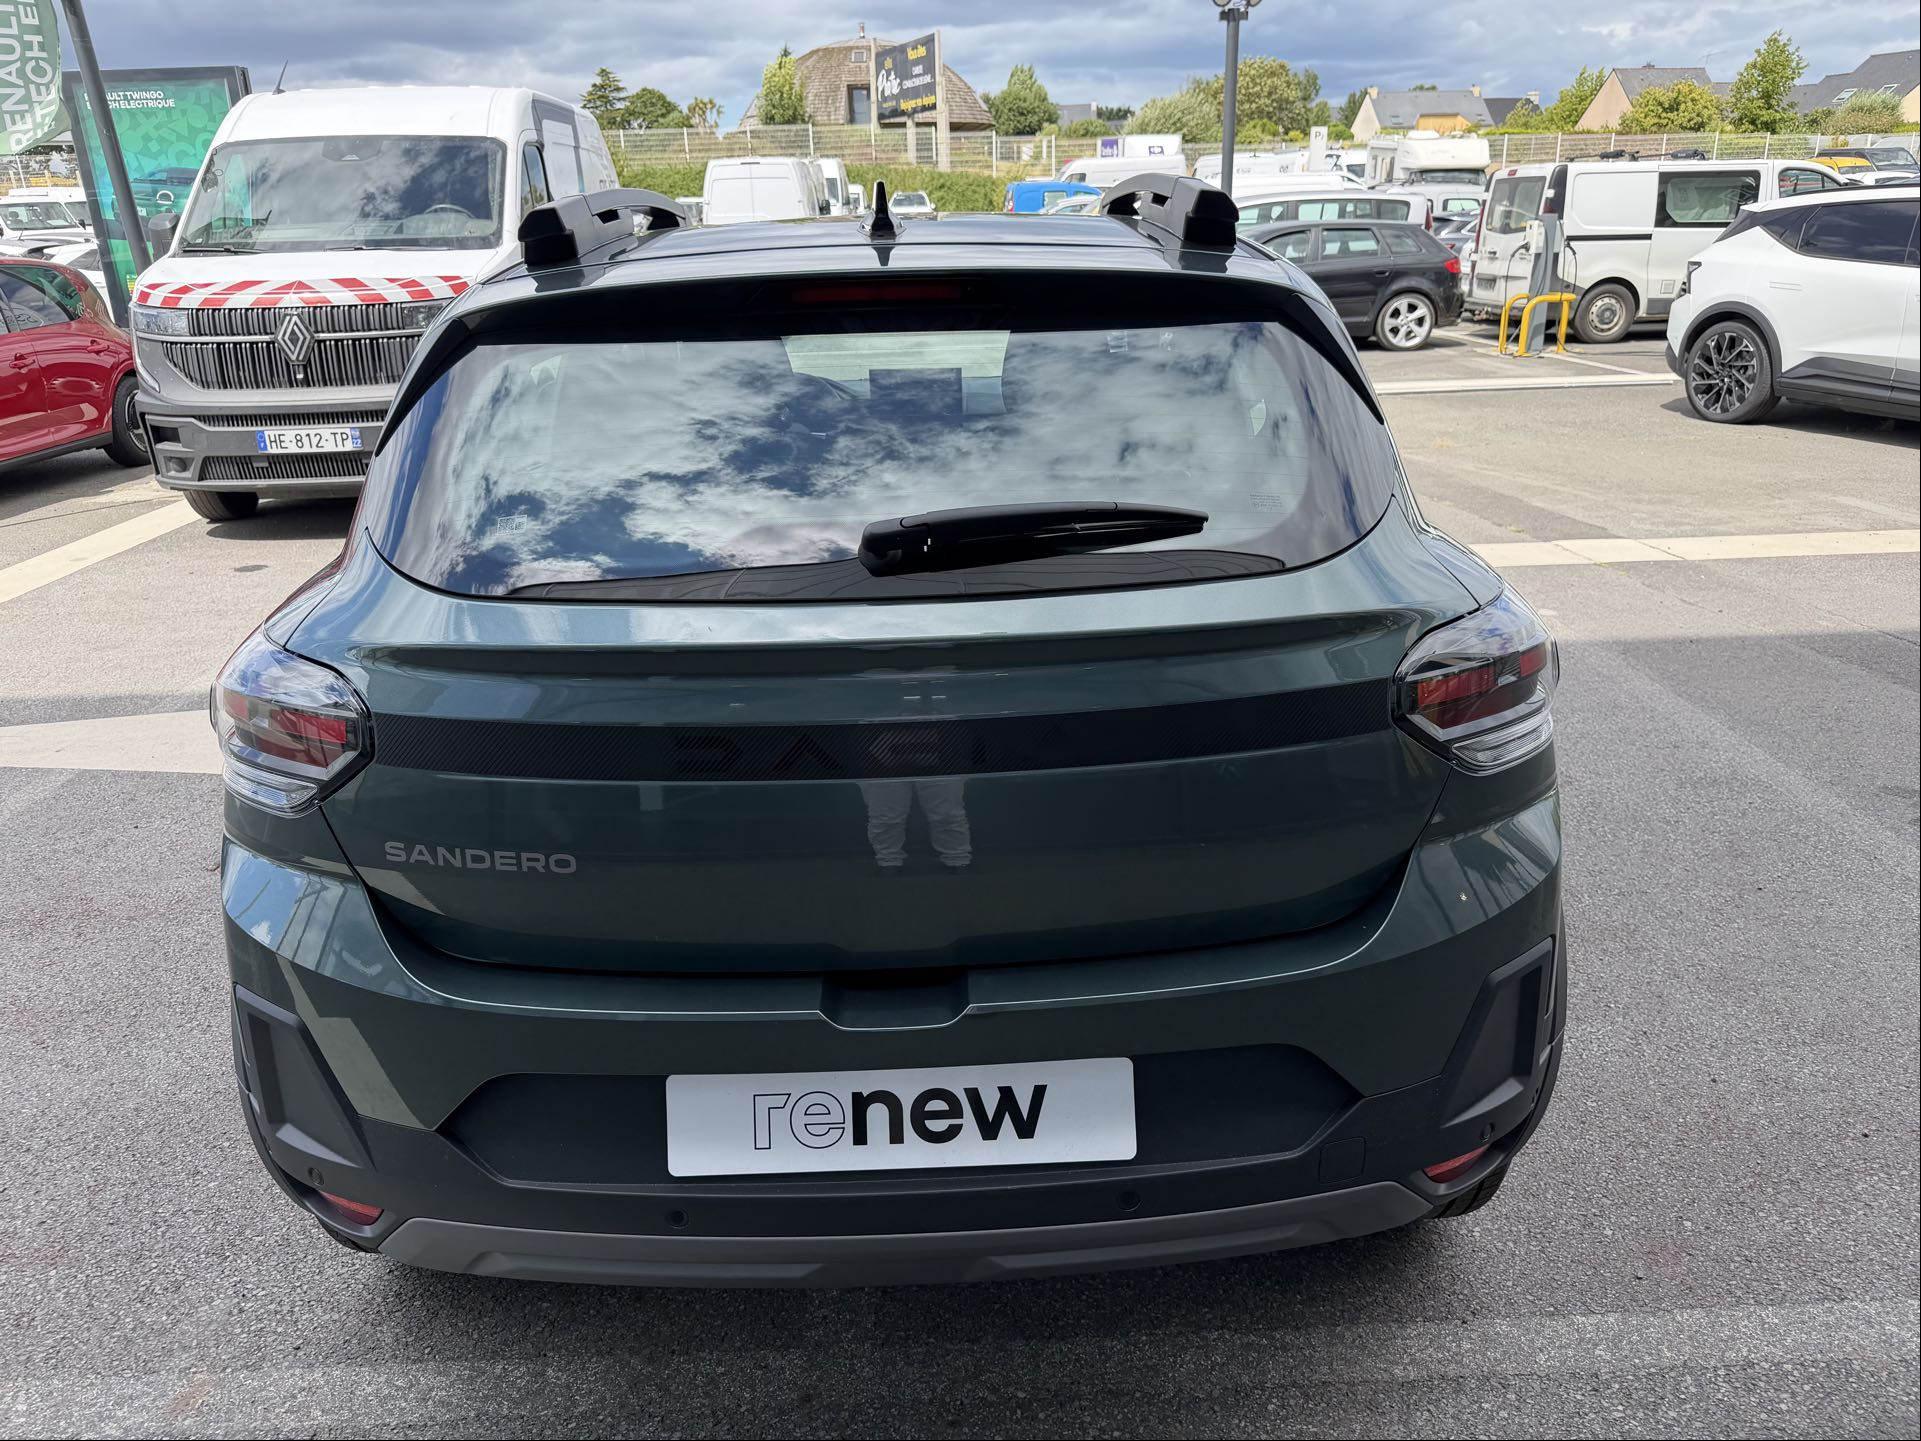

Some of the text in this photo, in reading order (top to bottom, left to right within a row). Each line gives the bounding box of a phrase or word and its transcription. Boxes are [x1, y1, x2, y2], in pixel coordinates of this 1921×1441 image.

[120, 99, 176, 109] ELECTRIQUE
[125, 90, 164, 100] TWINGO
[267, 431, 350, 450] HE-812-TP
[384, 841, 577, 874] SANDERO
[752, 1084, 1048, 1150] renew
